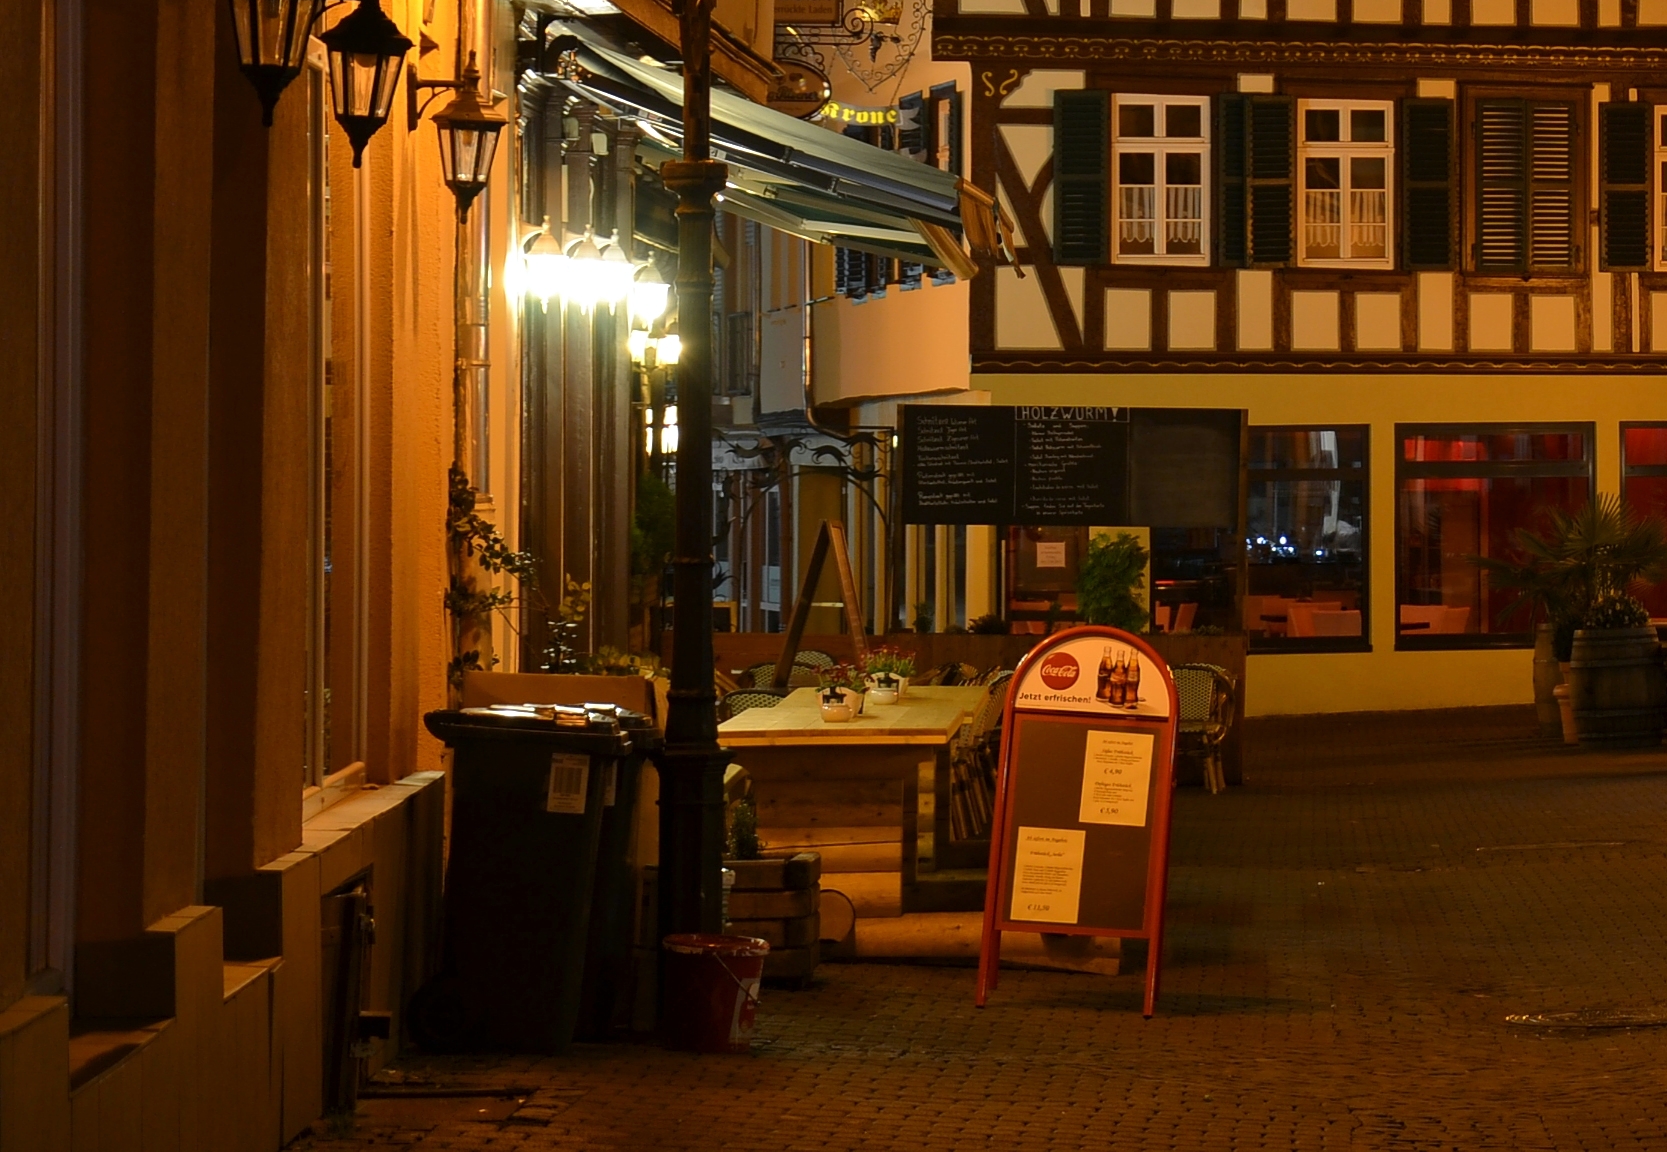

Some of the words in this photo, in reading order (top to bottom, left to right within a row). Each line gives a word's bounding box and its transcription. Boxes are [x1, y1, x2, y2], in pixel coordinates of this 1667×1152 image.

[774, 4, 805, 13] errückte
[820, 101, 898, 125] Krone
[1020, 693, 1041, 701] Jetzt
[1044, 694, 1091, 704] erfrischen!
